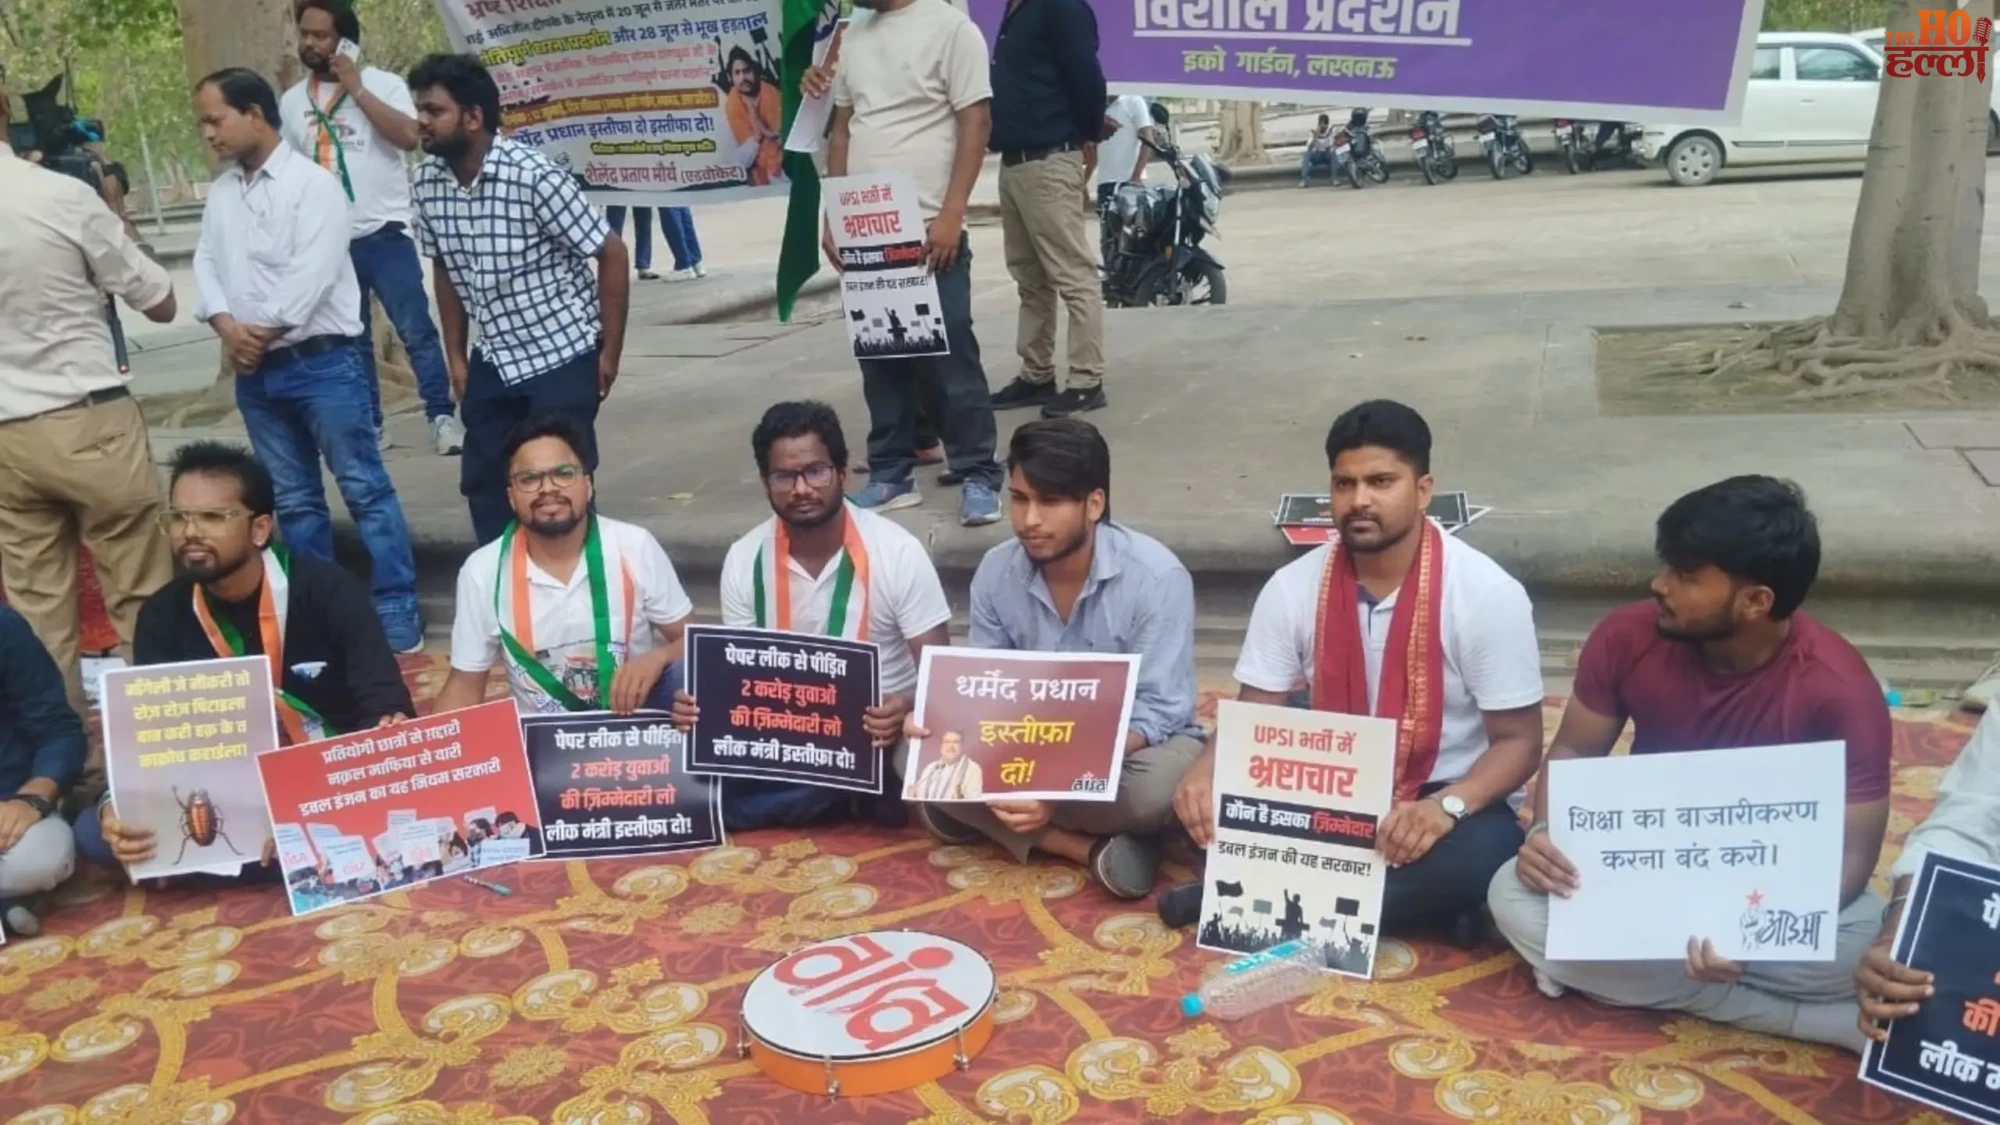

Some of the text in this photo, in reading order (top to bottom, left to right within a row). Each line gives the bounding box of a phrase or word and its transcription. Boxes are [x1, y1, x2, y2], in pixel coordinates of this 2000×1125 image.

[618, 7, 631, 17] 20
[633, 2, 650, 19] जून
[613, 25, 635, 43] और
[639, 27, 656, 40] 28
[658, 23, 679, 43] जून
[681, 18, 693, 35] से
[695, 20, 718, 40] भूख
[1183, 44, 1397, 80] इको गार्डन, लखनऊ
[546, 123, 584, 141] प्रधान
[635, 115, 646, 136] दो
[694, 111, 715, 134] दो!
[619, 166, 650, 184] प्रताप
[725, 643, 847, 678] पेपर लीक से पीड़ित
[742, 678, 837, 707] 2 करोड़ युवाओं
[1029, 678, 1100, 701] प्रधान
[730, 705, 842, 737] की ज़िम्मेदारी लो
[979, 715, 1075, 746] इस्तीफ़ा
[322, 738, 375, 764] प्रतियोगी
[377, 730, 406, 754] छात्रों
[409, 728, 423, 744] से
[555, 724, 682, 750] पेपर लीक से पीड़ित
[1254, 725, 1357, 754] UPSI भर्ती में
[419, 749, 433, 766] से
[435, 744, 463, 763] यारी
[571, 754, 671, 781] 2 करोड़ युवाओं
[712, 735, 855, 770] लीक मंत्री इस्तीफ़ा दो!
[1001, 757, 1036, 785] दो!
[1248, 755, 1358, 797] भ्रष्टाचार
[299, 757, 501, 817] डबल इंजन का यह नियम सरकारी
[559, 784, 677, 811] की ज़िम्मेदारी लो
[546, 813, 693, 842] लीक मंत्री इस्तीफ़ा दो!
[1225, 800, 1376, 840] कौन है इसका ज़िम्मेदार
[1569, 798, 1819, 833] शिक्षा का बाजारीकरण
[1217, 840, 1372, 878] डबल इंजन की यह सरकार!
[1600, 840, 1778, 870] करना बंद करो।
[1920, 1040, 1985, 1083] लीक
